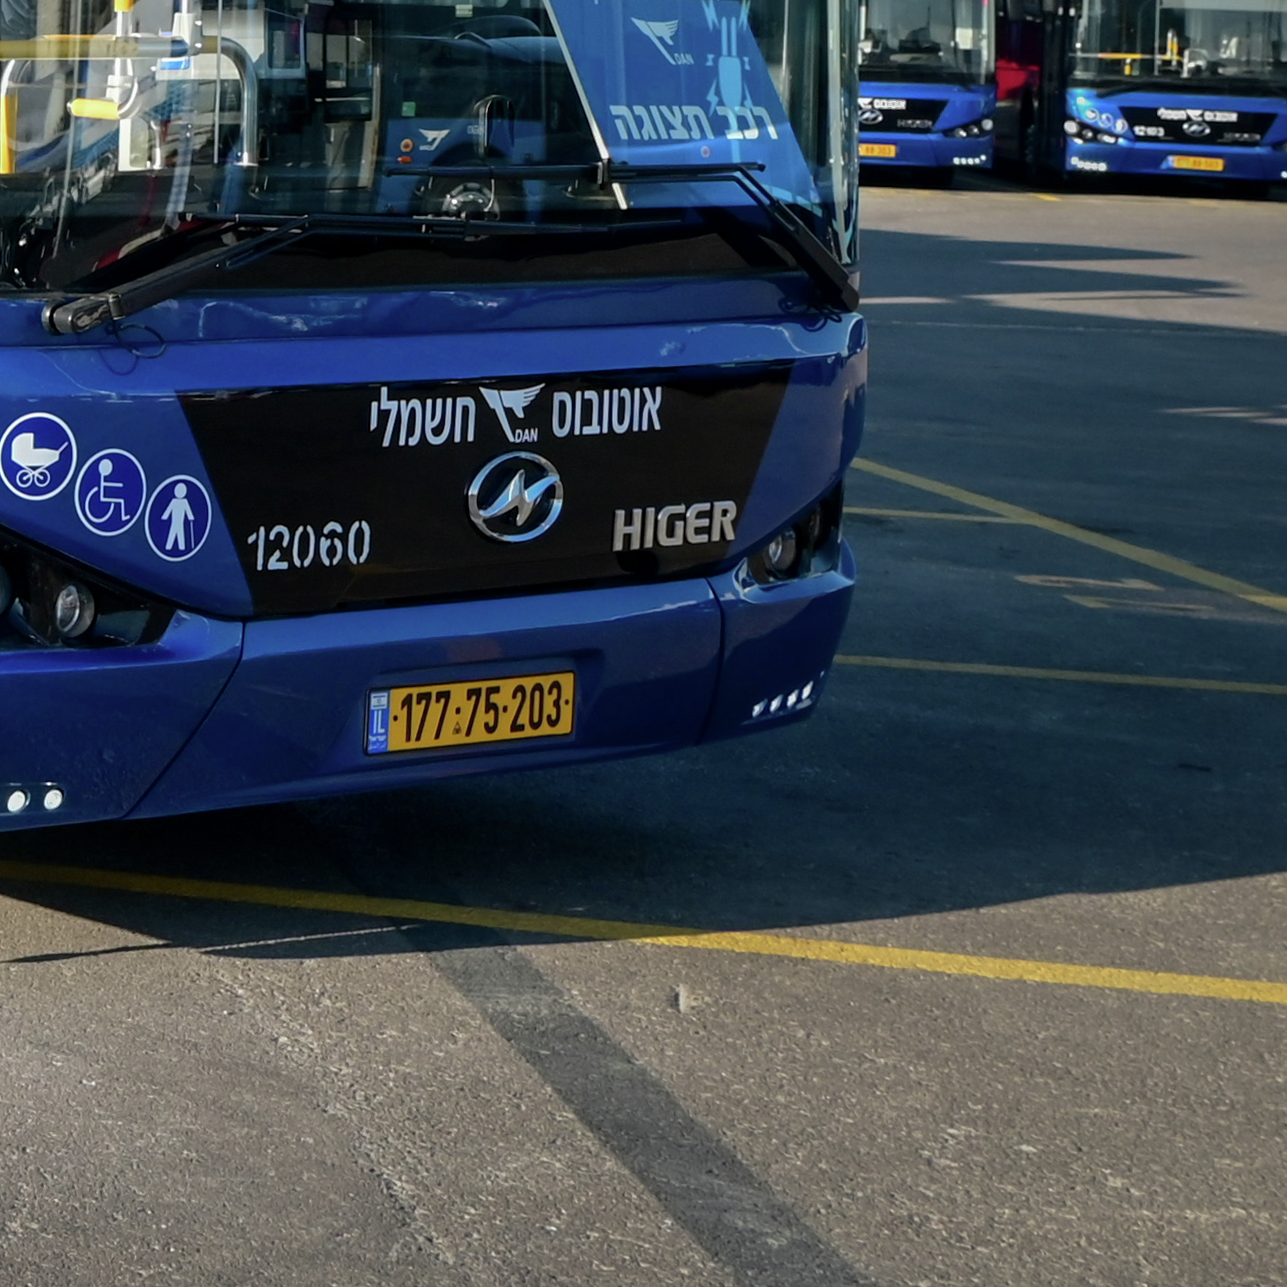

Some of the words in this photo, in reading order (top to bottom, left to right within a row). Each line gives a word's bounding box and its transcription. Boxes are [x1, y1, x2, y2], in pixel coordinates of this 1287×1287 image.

[674, 53, 695, 65] DAN
[609, 105, 715, 141] תצוגה
[716, 106, 778, 140] רכב
[369, 386, 476, 448] חשמלי
[552, 386, 663, 439] אוטובוס
[514, 428, 539, 444] DAN
[248, 519, 371, 571] 12060
[612, 500, 736, 552] HIGER
